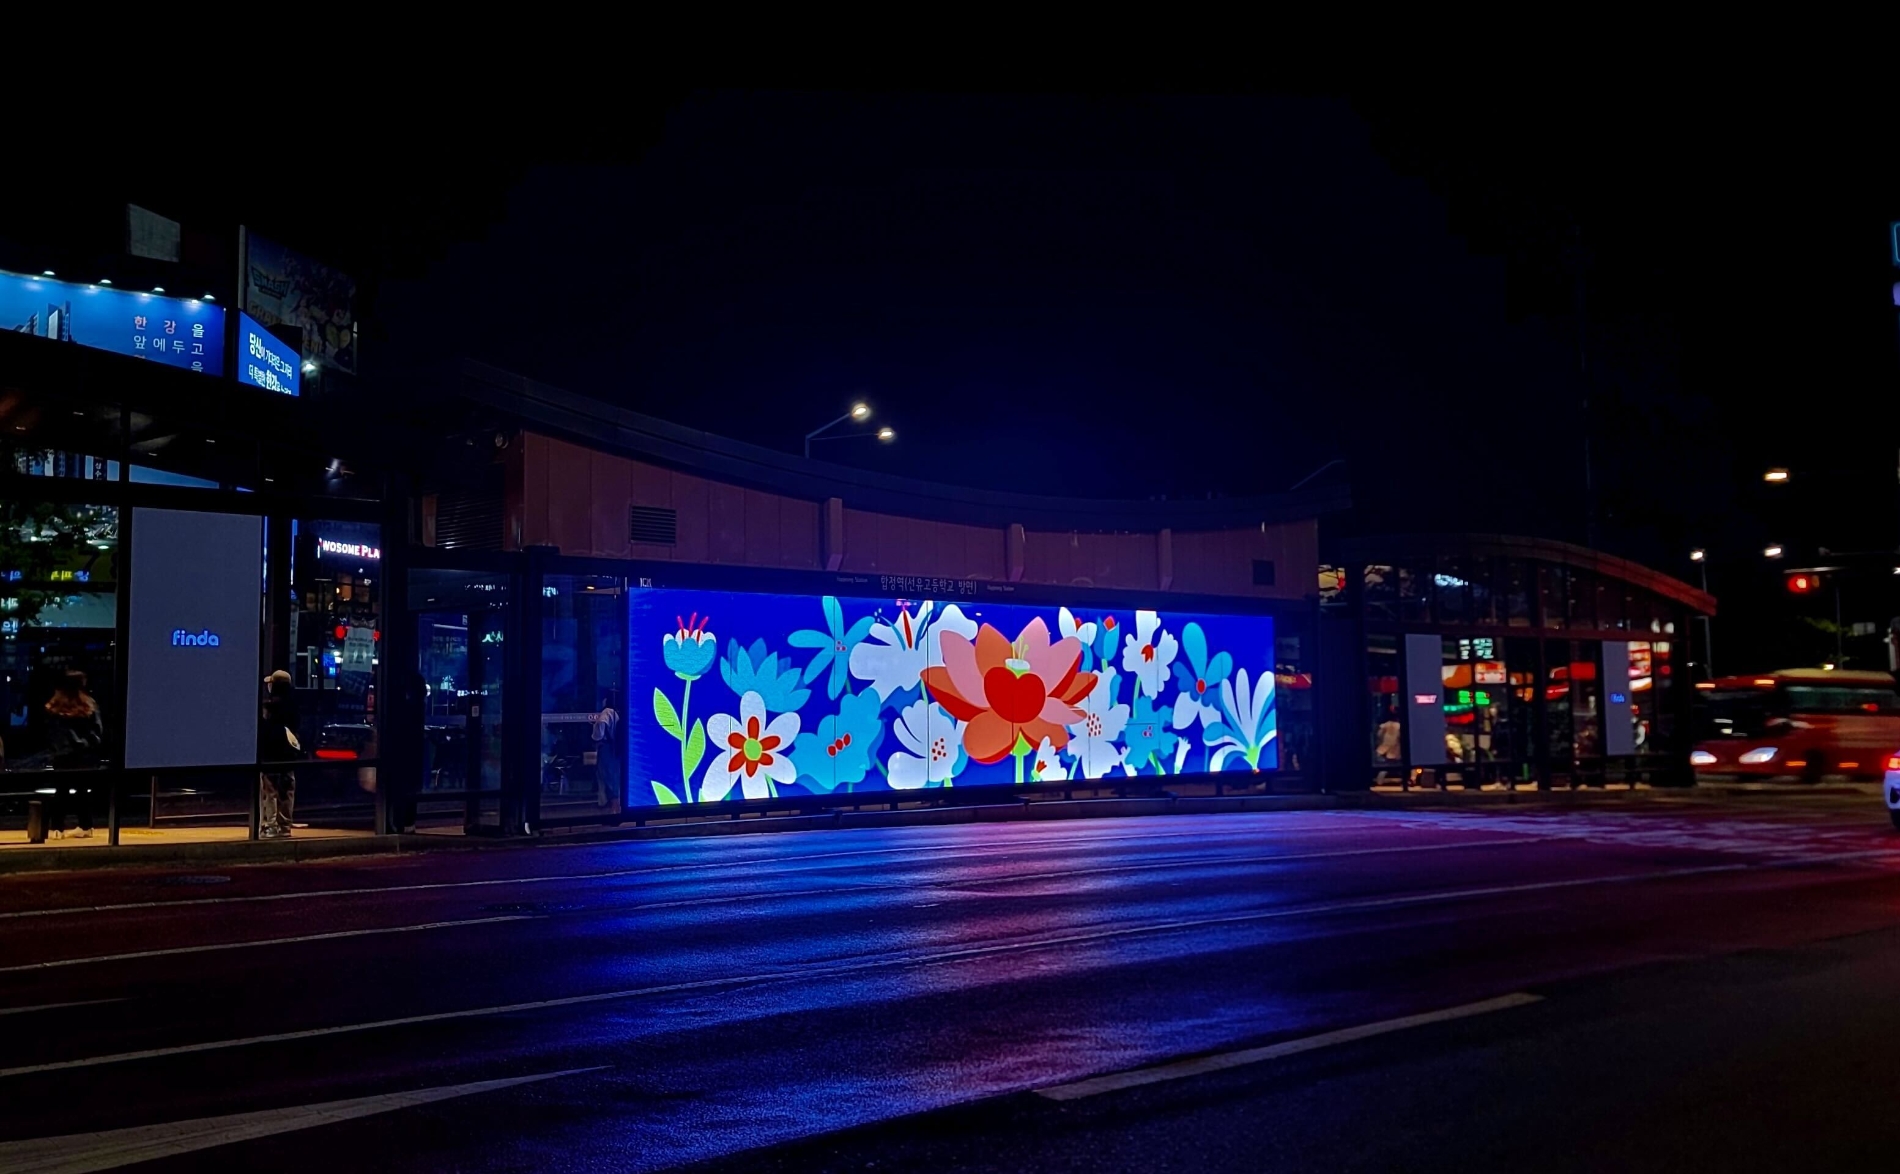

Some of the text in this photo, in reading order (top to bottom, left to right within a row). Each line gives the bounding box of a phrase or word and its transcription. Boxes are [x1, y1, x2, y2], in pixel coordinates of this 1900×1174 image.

[134, 315, 204, 338] 한강을
[133, 335, 204, 355] 앞에 두고
[958, 580, 977, 595] 방면)
[172, 630, 219, 646] finda
